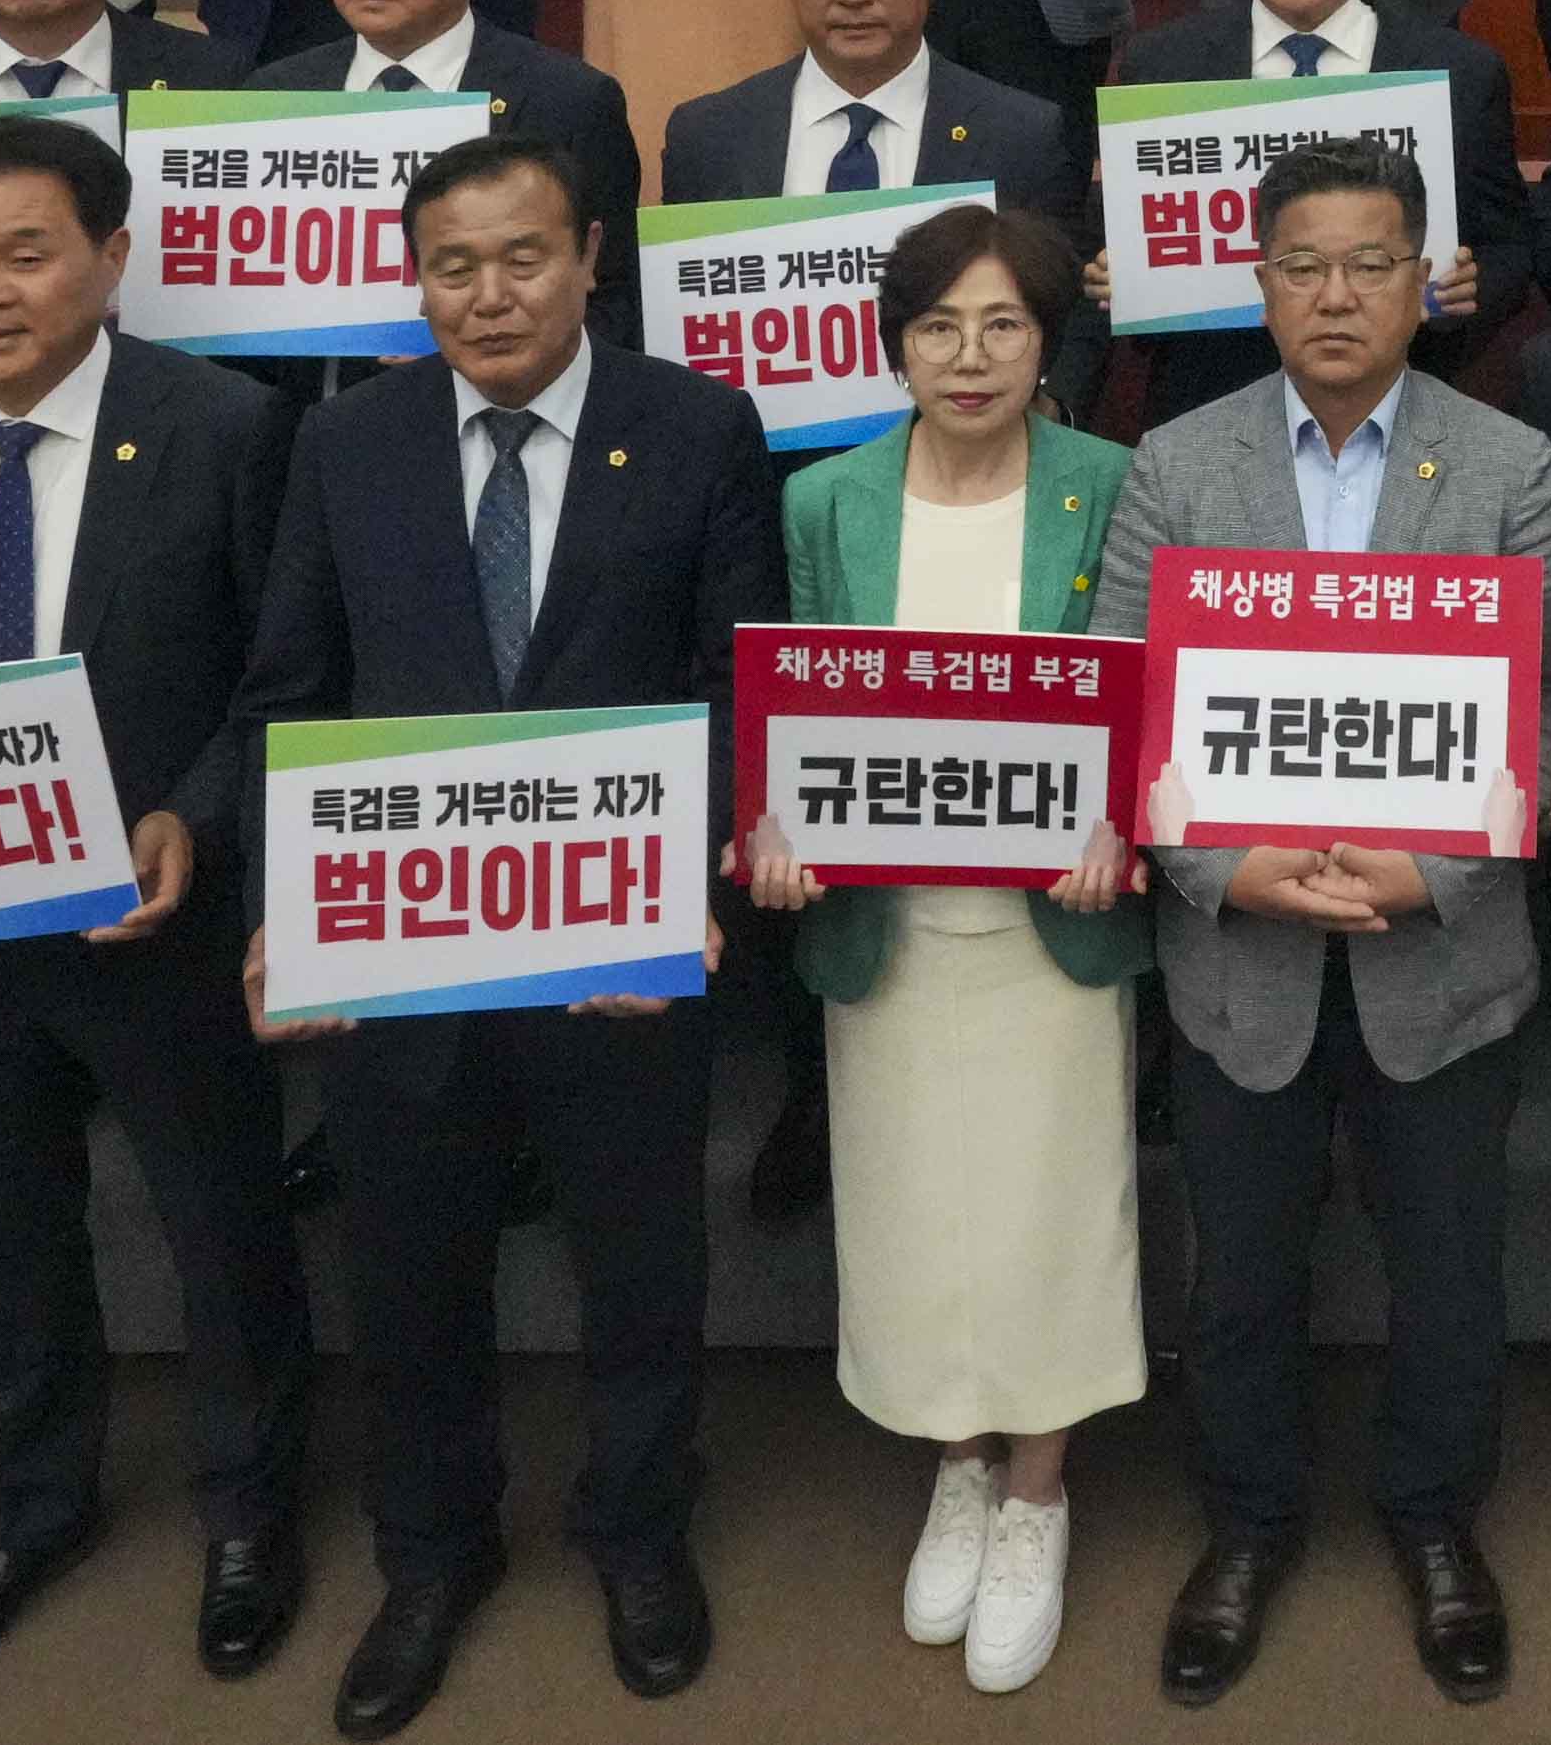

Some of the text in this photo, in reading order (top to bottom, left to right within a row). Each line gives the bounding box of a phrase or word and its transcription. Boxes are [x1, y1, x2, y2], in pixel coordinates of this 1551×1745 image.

[161, 149, 379, 190] 특검을 거부하는
[1187, 569, 1500, 623] 채상병 특검법 부결
[774, 646, 1100, 697] 채상병 특검법 부결
[1202, 695, 1478, 783] 규탄한다!
[311, 772, 665, 834] 특검을 거부하는 자가
[798, 756, 1078, 831] 규탄한다!
[314, 835, 663, 943] 범인이다!
